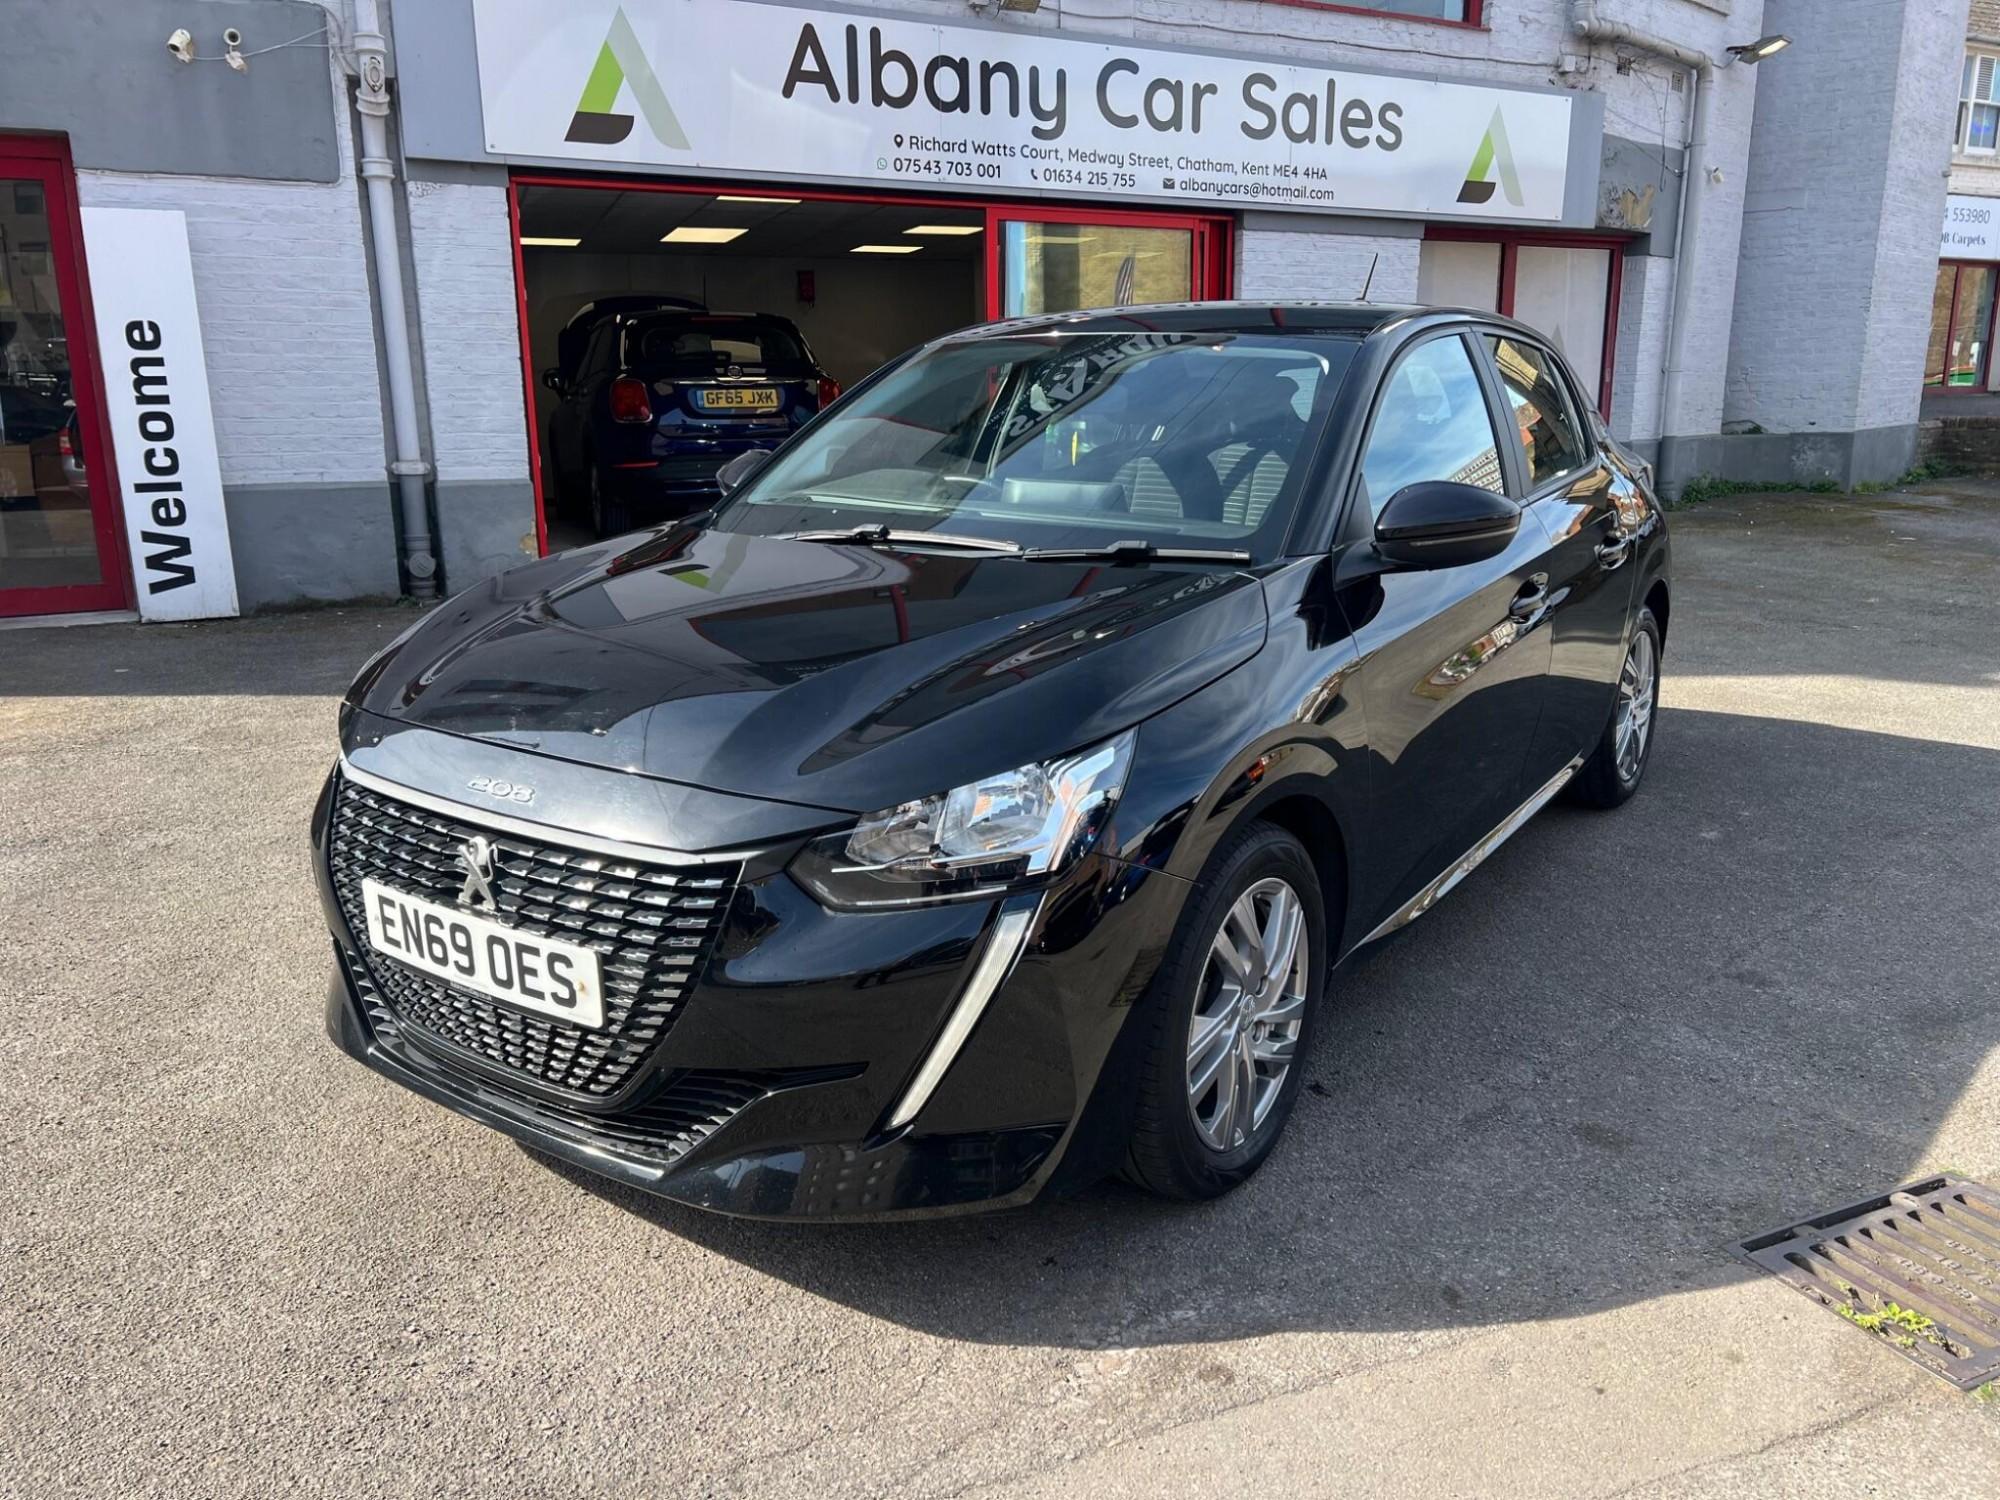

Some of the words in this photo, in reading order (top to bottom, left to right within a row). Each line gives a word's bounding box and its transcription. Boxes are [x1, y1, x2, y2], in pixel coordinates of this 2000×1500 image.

[782, 22, 1067, 141] Albany
[1096, 58, 1218, 134] Car
[1241, 72, 1404, 152] Sales
[893, 157, 941, 175] 07543
[946, 161, 972, 177] 703
[977, 163, 1001, 179] 001
[909, 135, 967, 154] Richard
[972, 140, 1016, 157] Watts
[1020, 144, 1063, 163] Court,
[1068, 148, 1124, 169] Medway
[1128, 152, 1173, 170] Street,
[1177, 156, 1237, 175] Chatham,
[1242, 161, 1269, 176] Kent
[1273, 164, 1298, 178] ME4
[1303, 167, 1327, 180] 4HA
[1043, 168, 1082, 184] 01634
[1087, 171, 1108, 186] 215
[1113, 173, 1136, 188] 755
[1180, 177, 1334, 201] albanycars@hotmail.com
[1952, 207, 1991, 225] 553980
[1952, 231, 1986, 248] Carpets
[706, 391, 743, 405] GF65
[748, 391, 775, 404] JXK
[125, 320, 196, 595] Welcome
[466, 775, 536, 804] 208
[378, 894, 476, 977] EN69
[486, 934, 577, 1009] OES
